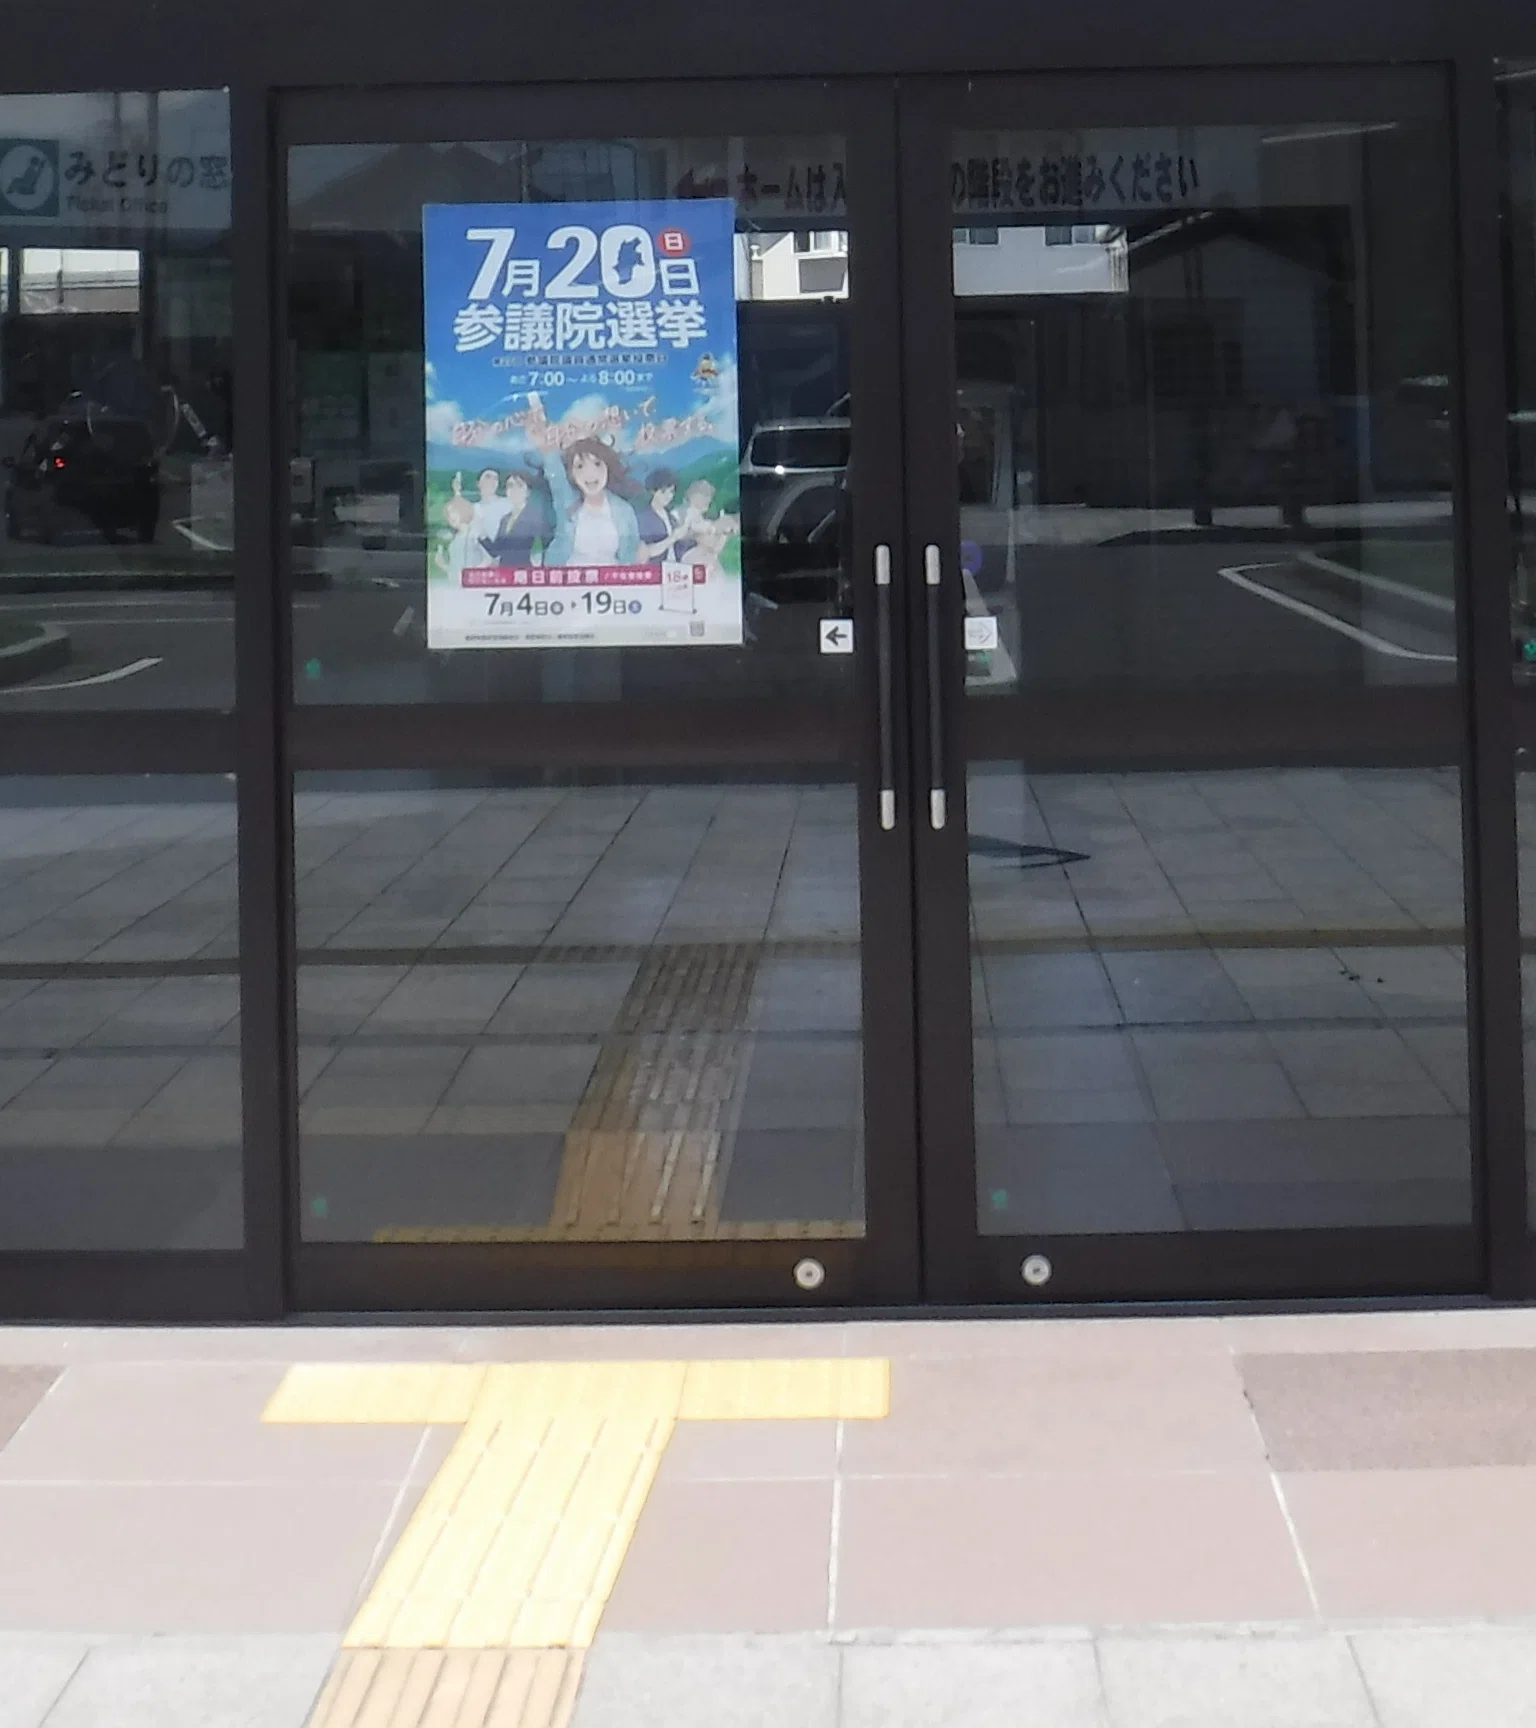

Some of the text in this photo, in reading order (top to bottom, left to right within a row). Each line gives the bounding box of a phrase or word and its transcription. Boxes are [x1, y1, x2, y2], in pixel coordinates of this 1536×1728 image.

[465, 224, 701, 300] 7月20日
[452, 299, 708, 352] 参議院選挙
